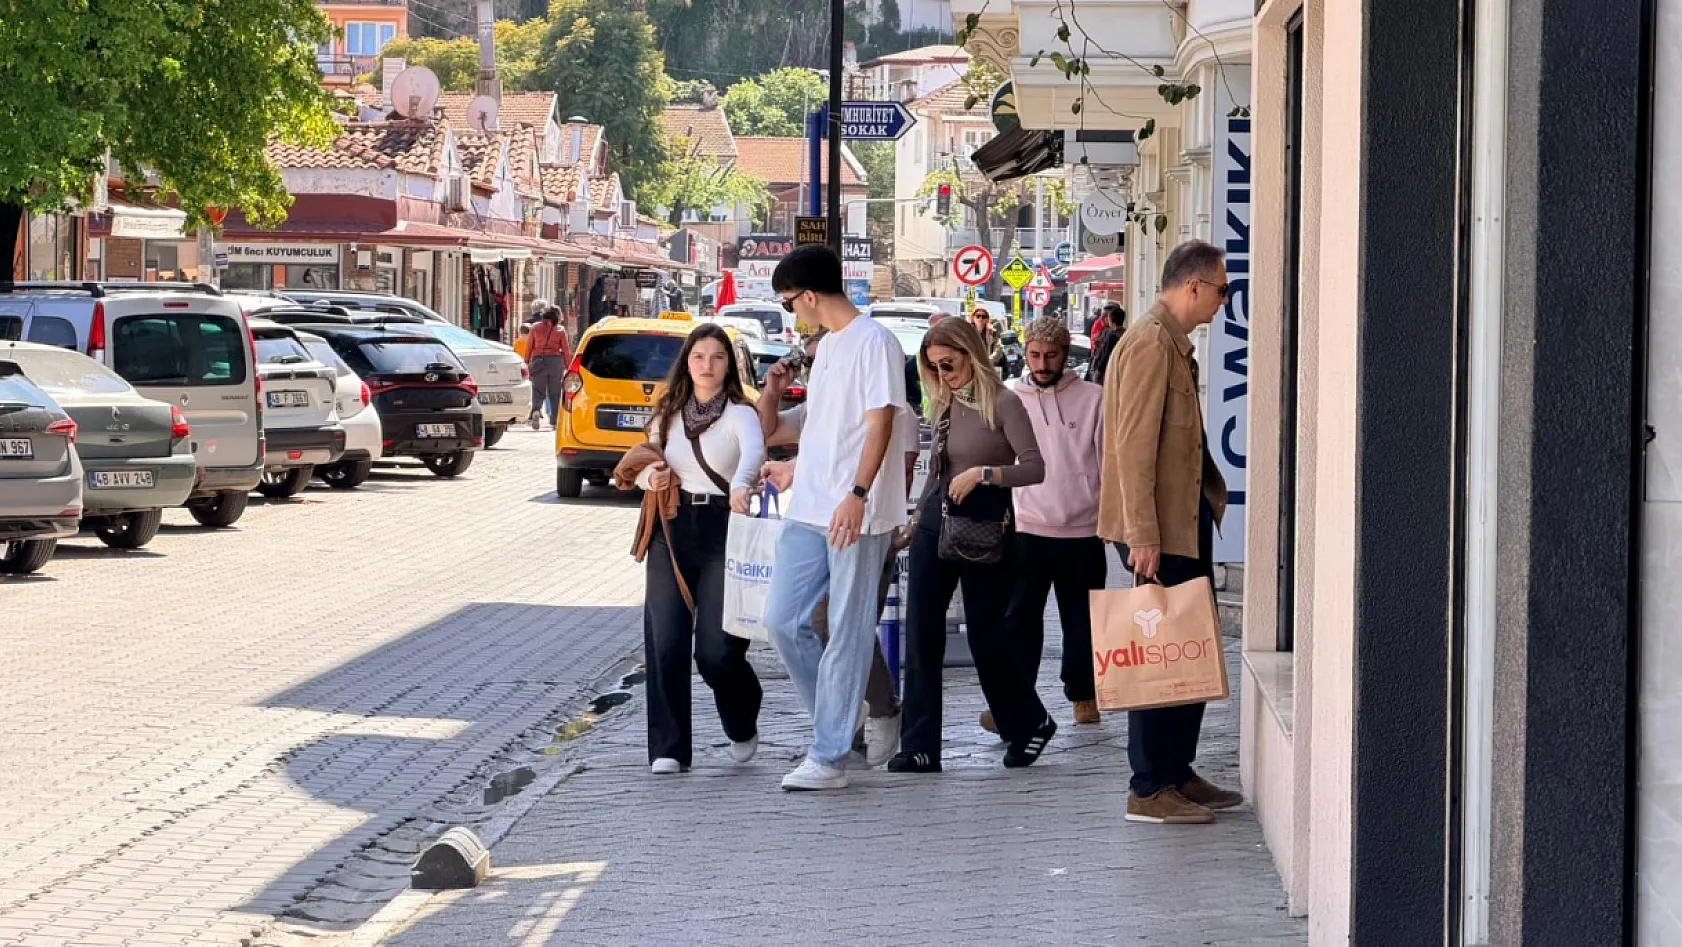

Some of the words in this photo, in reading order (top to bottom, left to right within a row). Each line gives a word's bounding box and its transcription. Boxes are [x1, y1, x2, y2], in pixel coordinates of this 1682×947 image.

[841, 124, 887, 135] SOKAK
[1086, 203, 1122, 220] Özyer
[266, 246, 333, 257] KUYUMCULUK
[11, 441, 29, 454] 967
[96, 473, 109, 485] 48
[134, 472, 152, 485] 248
